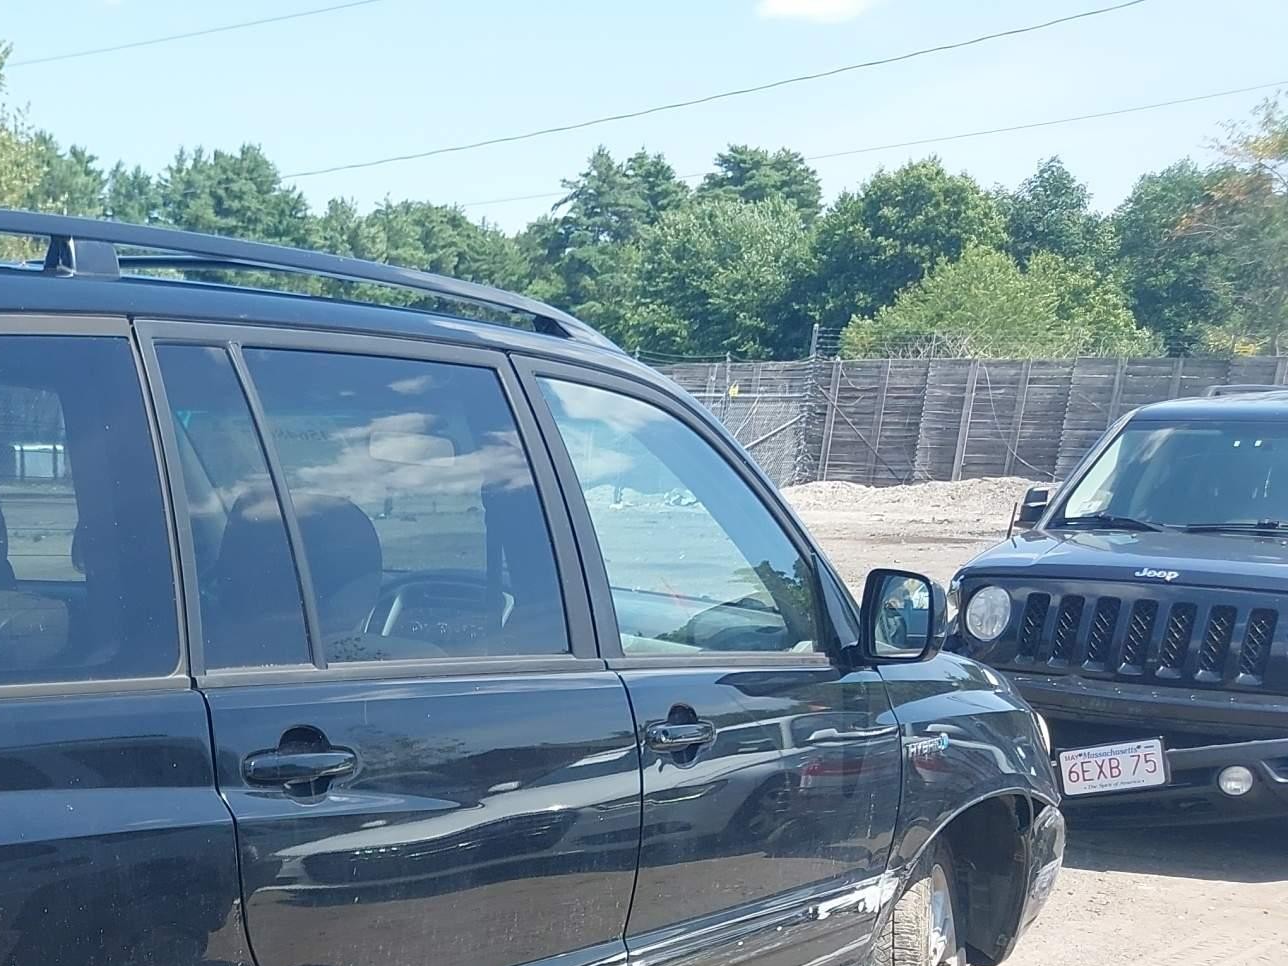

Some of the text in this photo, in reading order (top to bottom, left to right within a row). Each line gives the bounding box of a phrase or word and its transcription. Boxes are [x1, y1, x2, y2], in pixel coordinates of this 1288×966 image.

[1134, 567, 1179, 582] Jeep
[1082, 746, 1138, 760] Massachusetts
[1068, 752, 1158, 784] 6EXB 75
